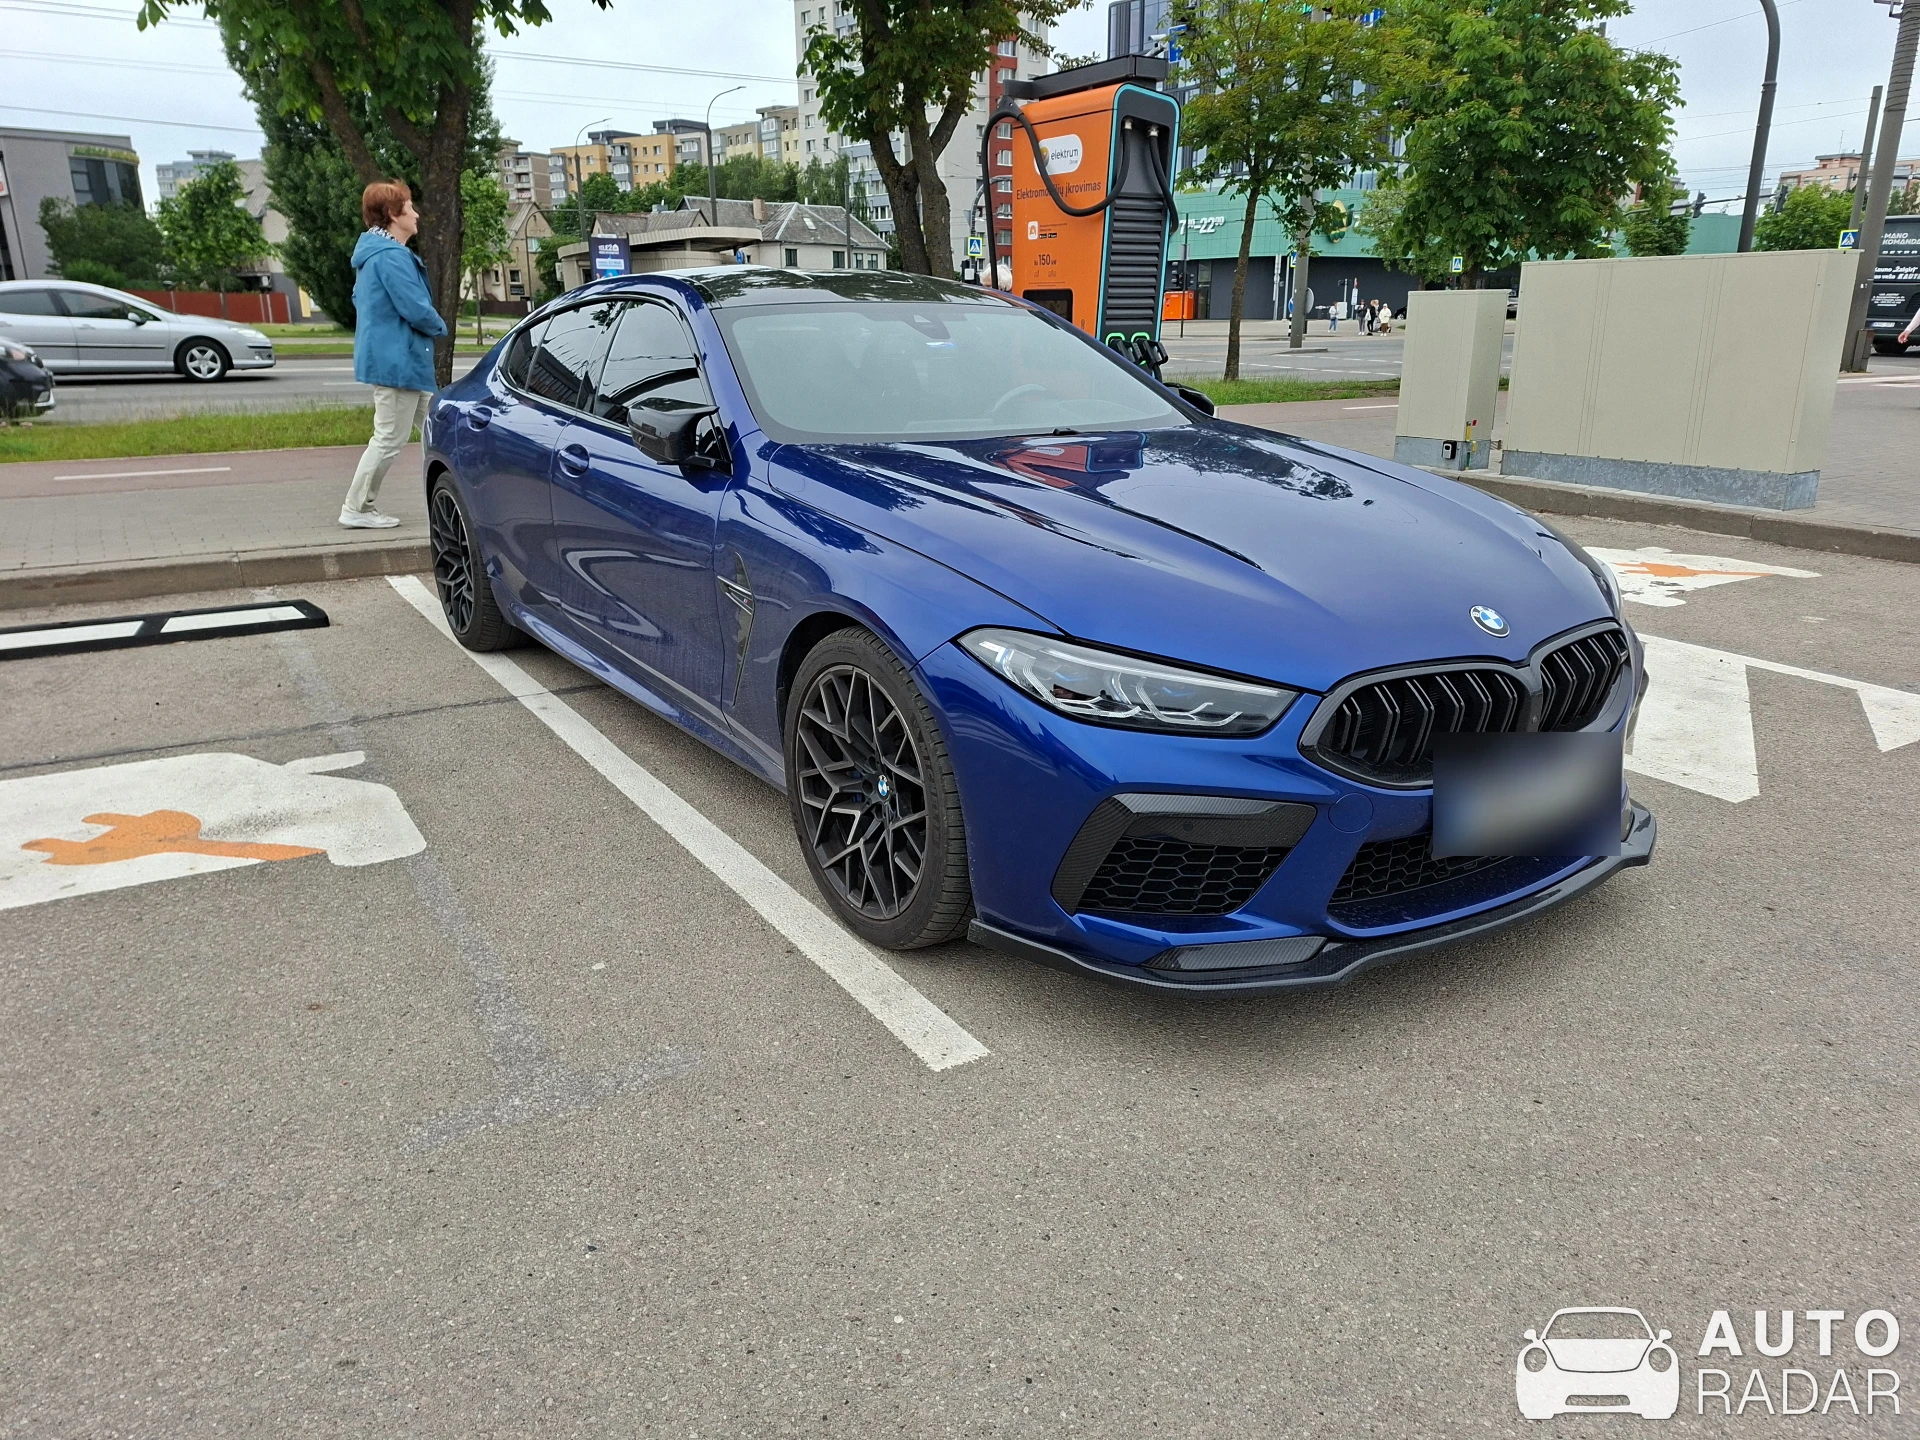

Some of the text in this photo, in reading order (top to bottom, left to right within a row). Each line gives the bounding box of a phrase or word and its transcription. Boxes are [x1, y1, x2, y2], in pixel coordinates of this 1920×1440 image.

[1051, 148, 1079, 160] elektrum
[1065, 180, 1102, 197] įkrovimas
[1038, 253, 1051, 266] 150
